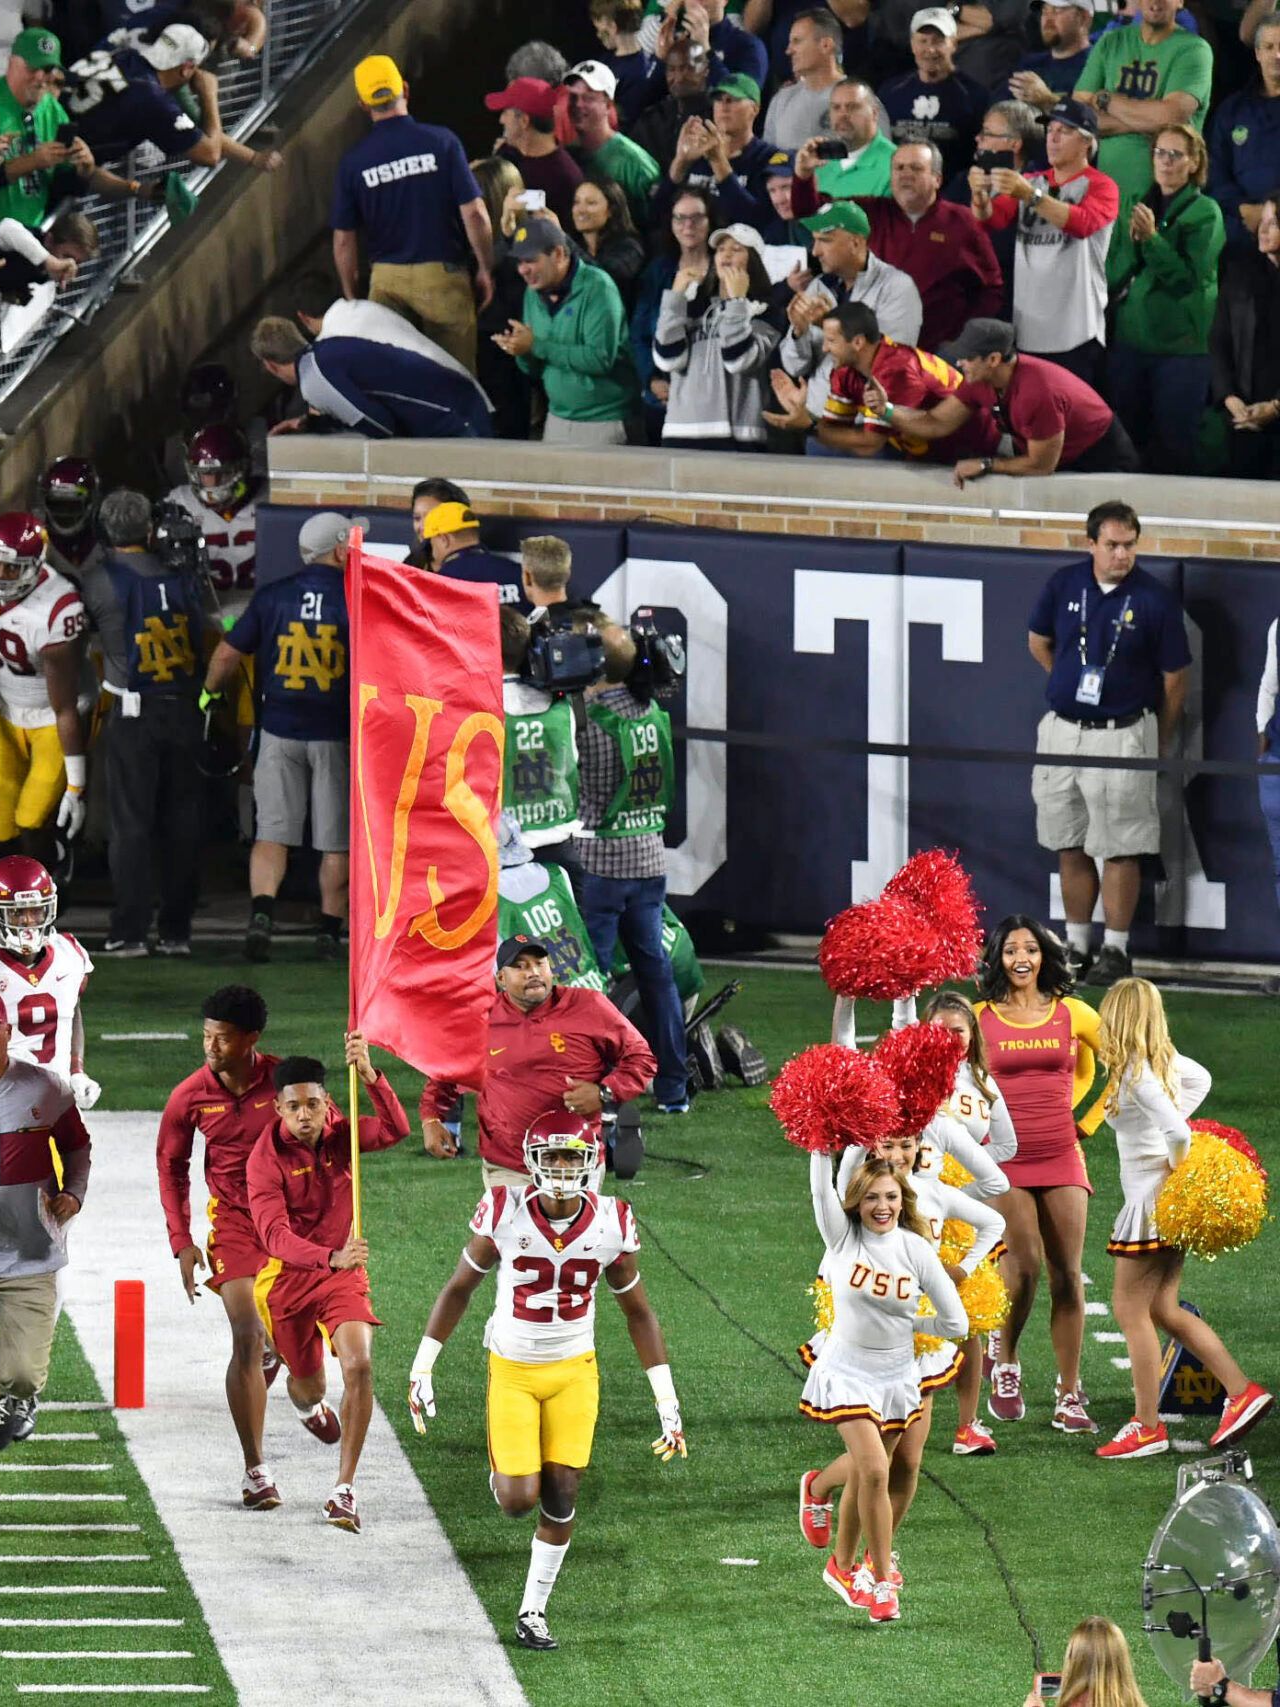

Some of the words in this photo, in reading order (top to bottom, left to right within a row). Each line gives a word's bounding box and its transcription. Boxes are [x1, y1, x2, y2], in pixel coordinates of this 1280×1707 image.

[361, 153, 438, 188] USHER
[158, 583, 168, 611] 1
[300, 592, 323, 621] 21
[275, 622, 346, 692] ND
[515, 721, 545, 750] 22
[630, 724, 659, 756] 139
[523, 899, 563, 938] 106
[17, 992, 58, 1064] 9
[998, 1038, 1060, 1051] TROJANS
[512, 1254, 601, 1323] 28
[849, 1263, 911, 1301] USC
